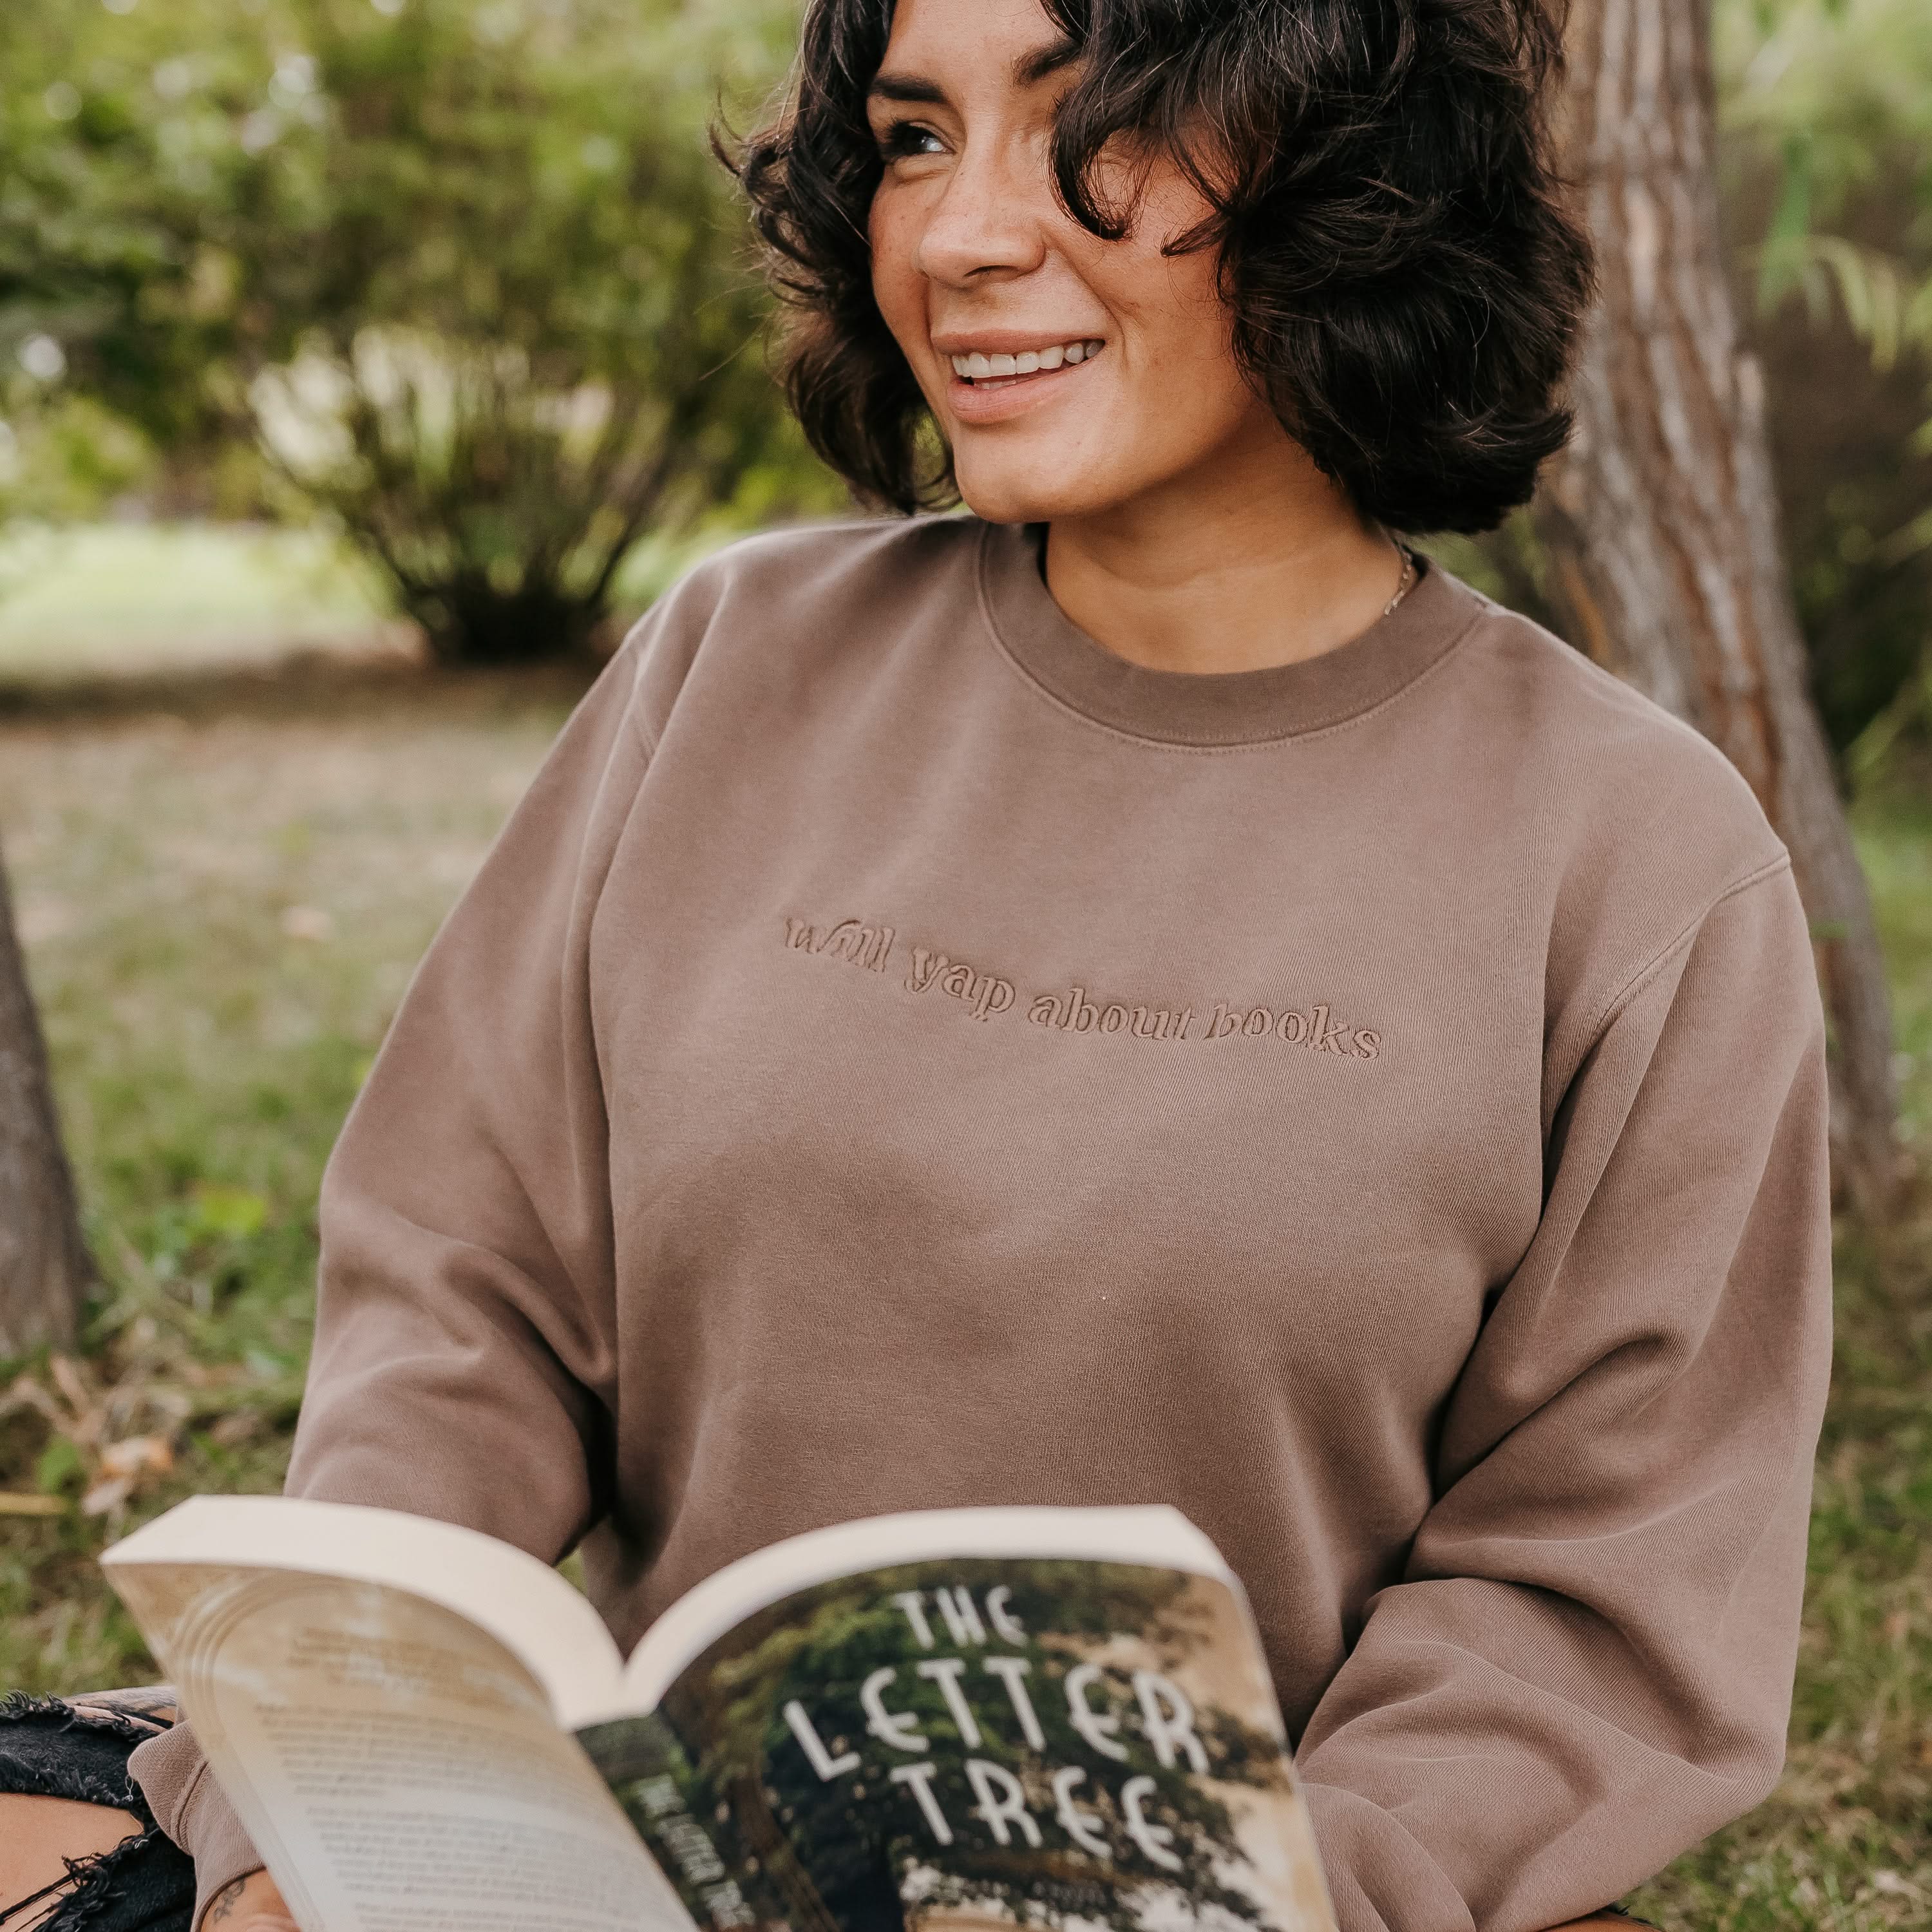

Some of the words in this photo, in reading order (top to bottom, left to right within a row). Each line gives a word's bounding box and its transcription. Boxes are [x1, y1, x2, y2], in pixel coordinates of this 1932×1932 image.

[784, 916, 896, 973] will
[904, 947, 1016, 1021] yap
[1028, 987, 1197, 1041] about
[1202, 1002, 1382, 1061] books
[896, 1584, 1028, 1649] THE
[783, 1656, 1210, 1776] LETTER
[889, 1759, 1183, 1873] TREE
